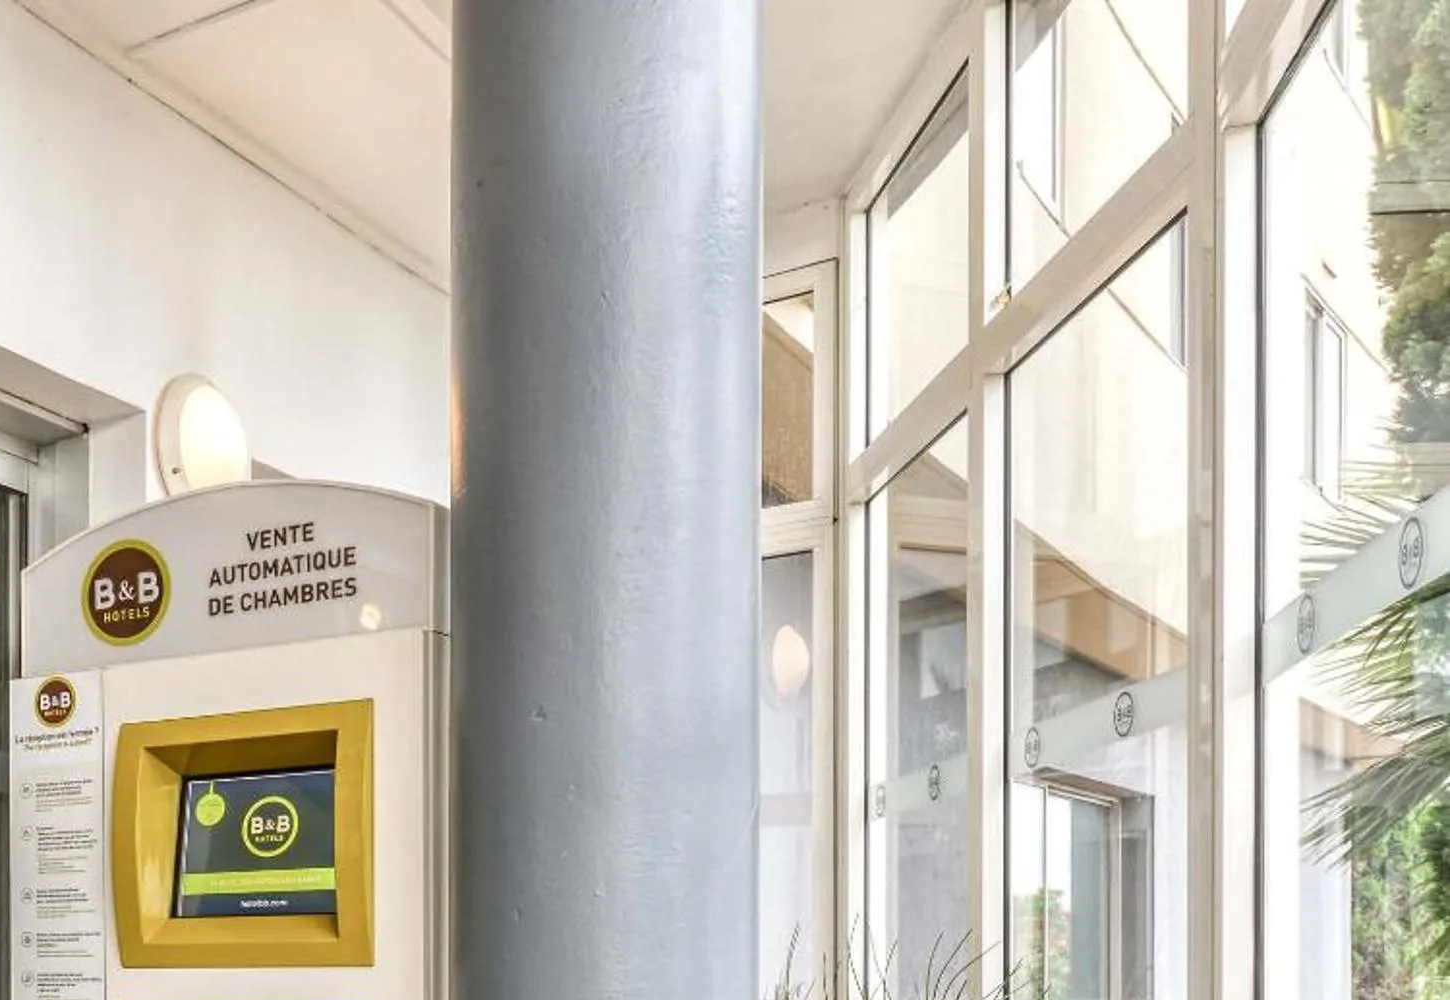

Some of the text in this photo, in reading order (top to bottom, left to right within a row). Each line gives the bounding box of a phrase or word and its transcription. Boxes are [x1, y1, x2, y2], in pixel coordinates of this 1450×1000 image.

[247, 522, 314, 550] VENTE
[208, 547, 357, 588] AUTOMATIQUE
[93, 571, 160, 611] B&B
[208, 577, 357, 616] DE CHAMBRES
[103, 606, 150, 624] HOTELS
